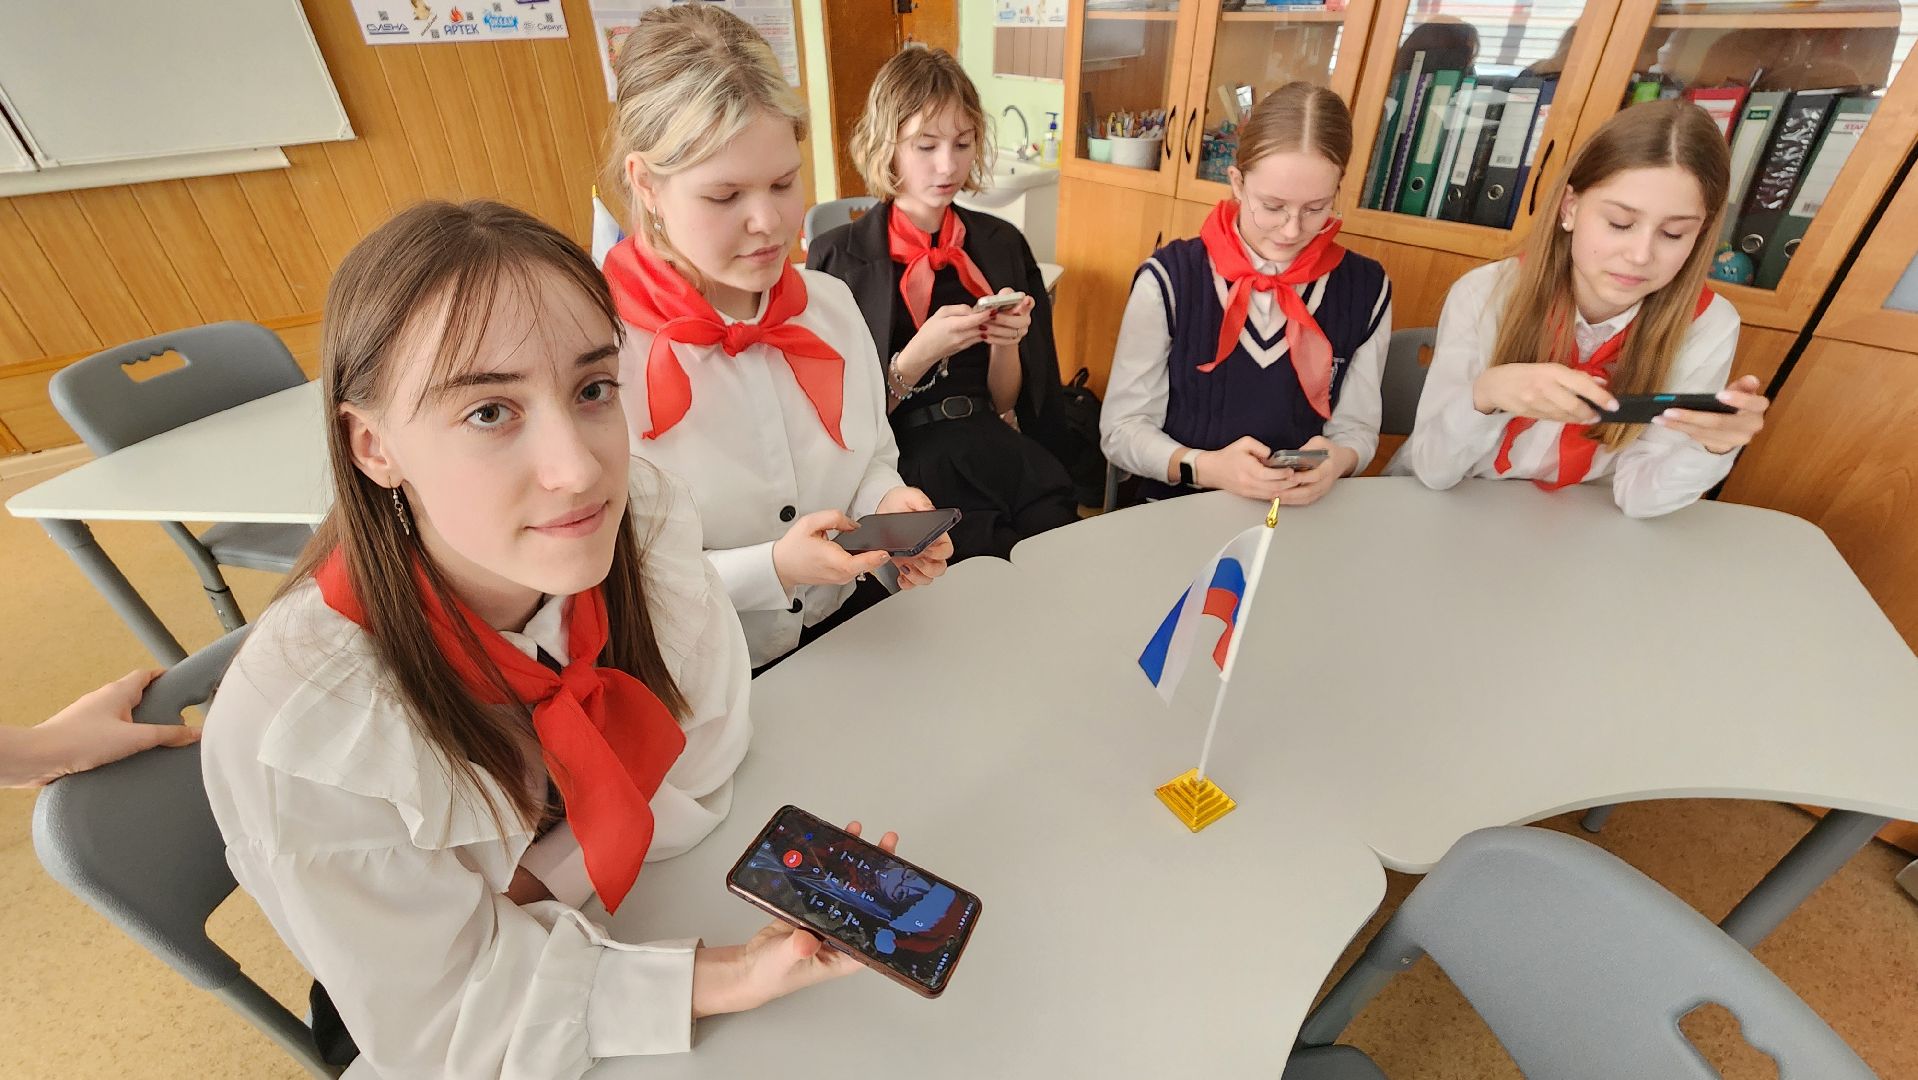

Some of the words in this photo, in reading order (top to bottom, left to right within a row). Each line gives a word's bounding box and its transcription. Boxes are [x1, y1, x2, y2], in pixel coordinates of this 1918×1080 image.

[443, 23, 480, 36] АРТЕК
[847, 855, 854, 863] 7
[866, 894, 875, 902] 2
[833, 909, 842, 917] 6
[851, 917, 860, 926] 3
[915, 920, 924, 928] 3
